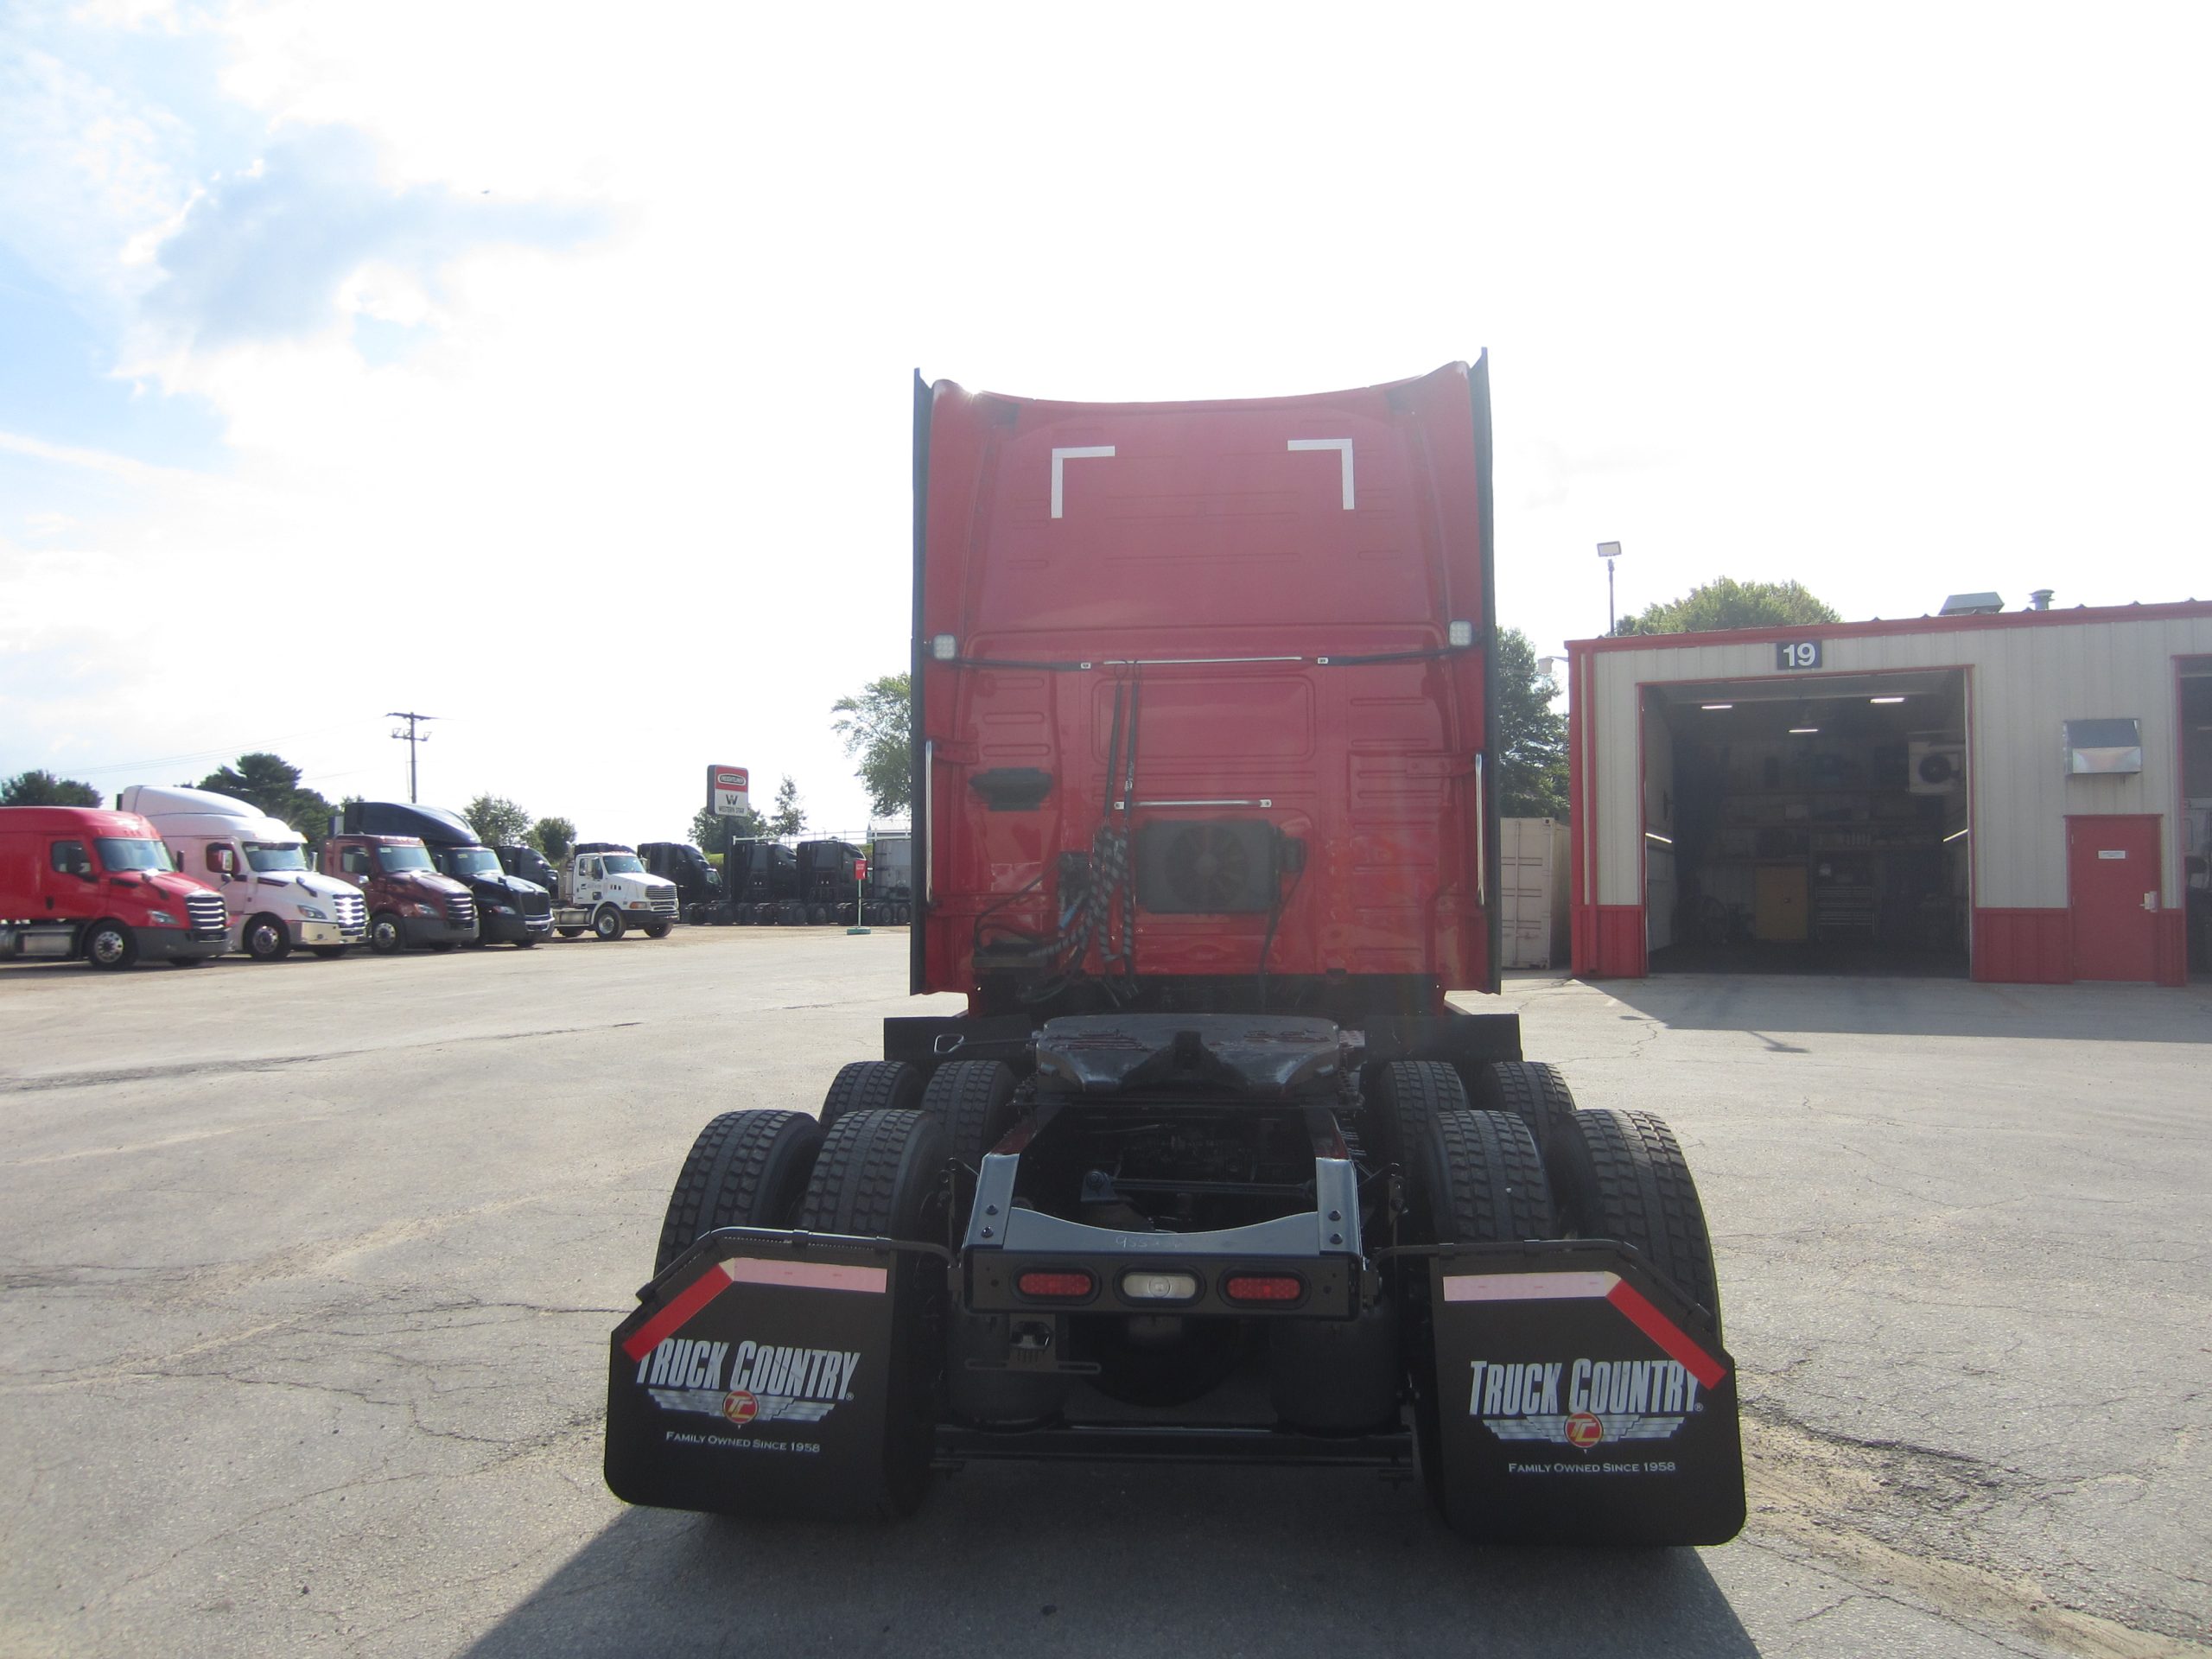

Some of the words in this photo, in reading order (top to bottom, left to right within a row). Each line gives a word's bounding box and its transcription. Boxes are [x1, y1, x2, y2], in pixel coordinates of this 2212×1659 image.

[1783, 643, 1815, 666] 19
[731, 1340, 861, 1400] COUNTRY
[1470, 1360, 1562, 1414] TRUCK
[1568, 1358, 1699, 1414] COUNTRY
[666, 1431, 705, 1443] FAMILY
[709, 1435, 751, 1447] OWNED
[753, 1440, 787, 1451] SINCE
[791, 1442, 820, 1453] 1958
[1509, 1463, 1551, 1472] FAMILY
[1554, 1463, 1600, 1472] OWNED
[1603, 1462, 1640, 1472] SINCE
[1643, 1461, 1675, 1471] 1958
